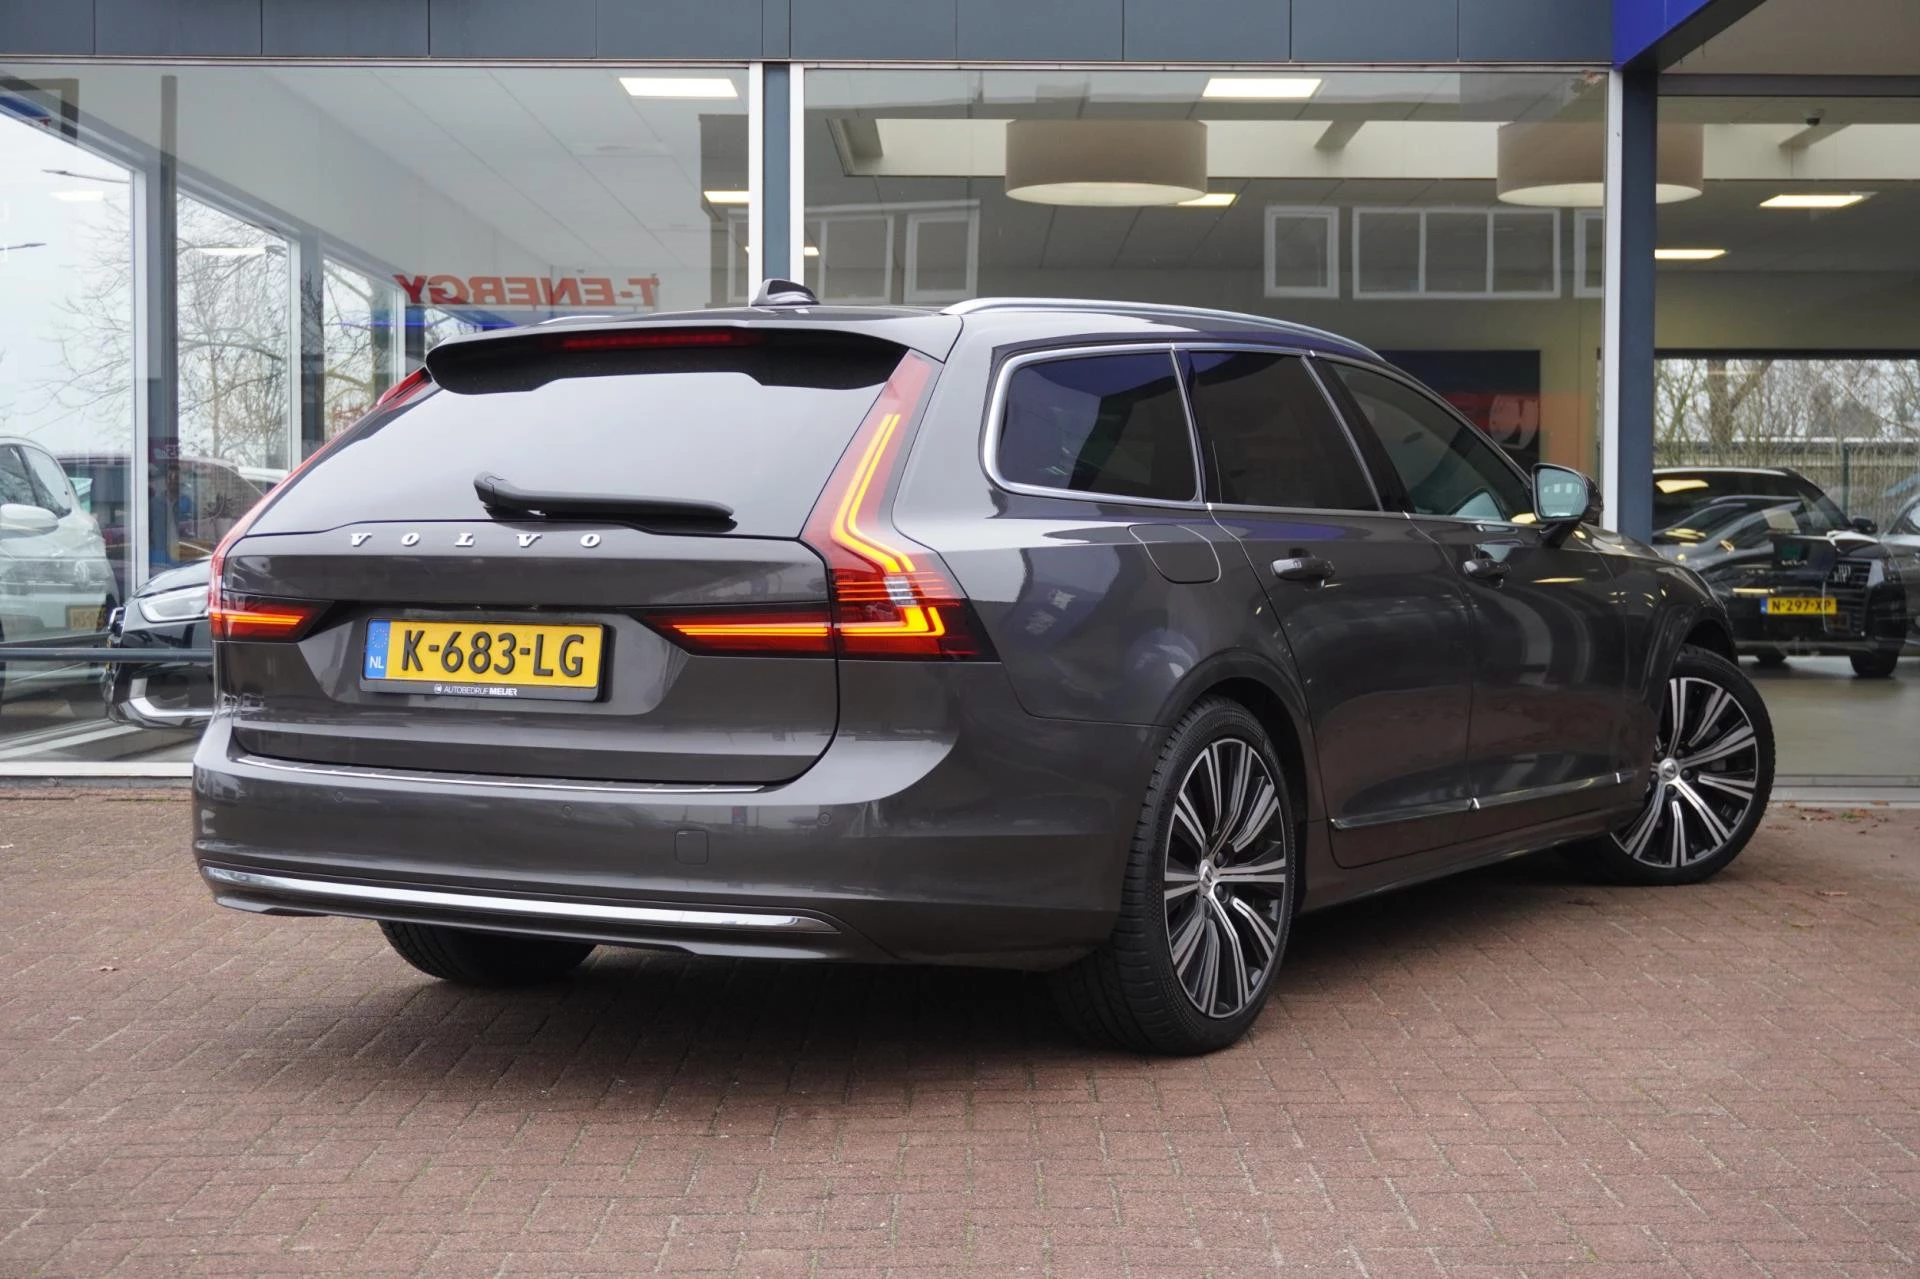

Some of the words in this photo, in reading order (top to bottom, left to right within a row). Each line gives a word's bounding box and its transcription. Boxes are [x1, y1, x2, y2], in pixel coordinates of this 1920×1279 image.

[350, 532, 601, 548] VOLVO
[1771, 600, 1832, 612] N-297-XP
[401, 629, 585, 678] K-683-LG
[369, 656, 385, 669] NL
